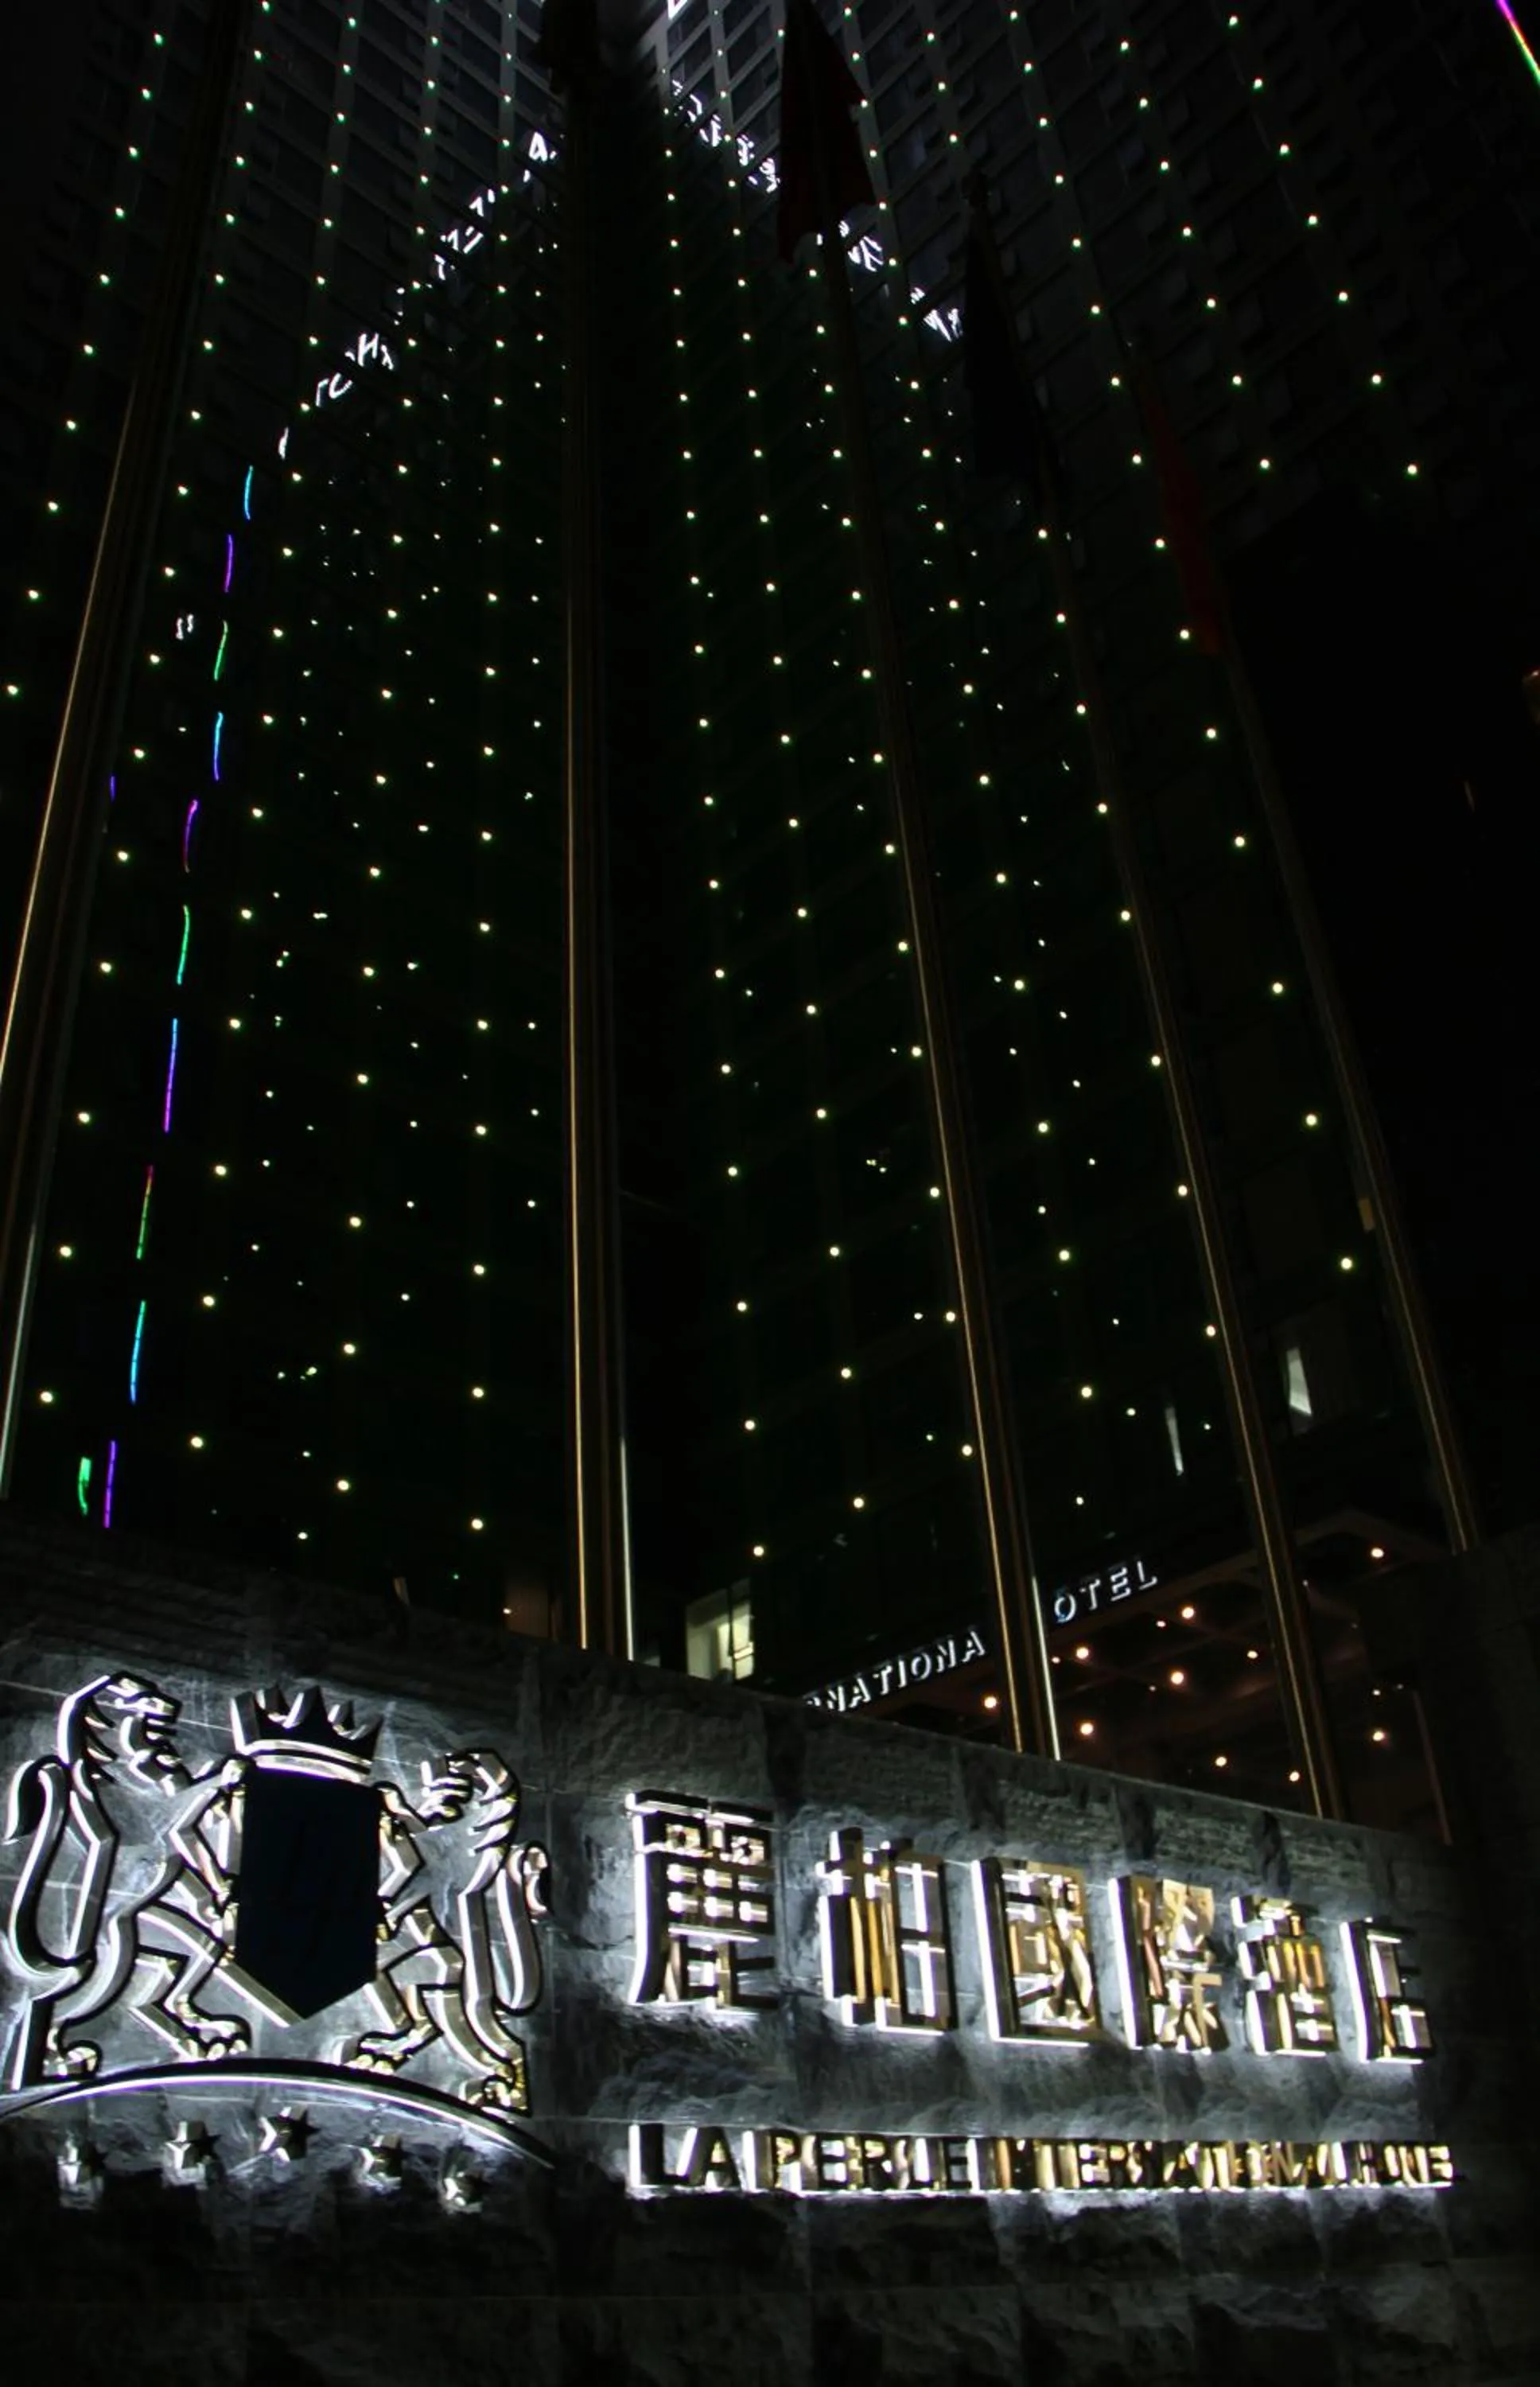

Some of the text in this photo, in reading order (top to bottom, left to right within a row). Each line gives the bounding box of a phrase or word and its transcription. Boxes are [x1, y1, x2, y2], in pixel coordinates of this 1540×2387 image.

[803, 1556, 1159, 1713] NATIONA OTEL
[627, 2123, 740, 2193] LA
[741, 2128, 974, 2194] PERLE
